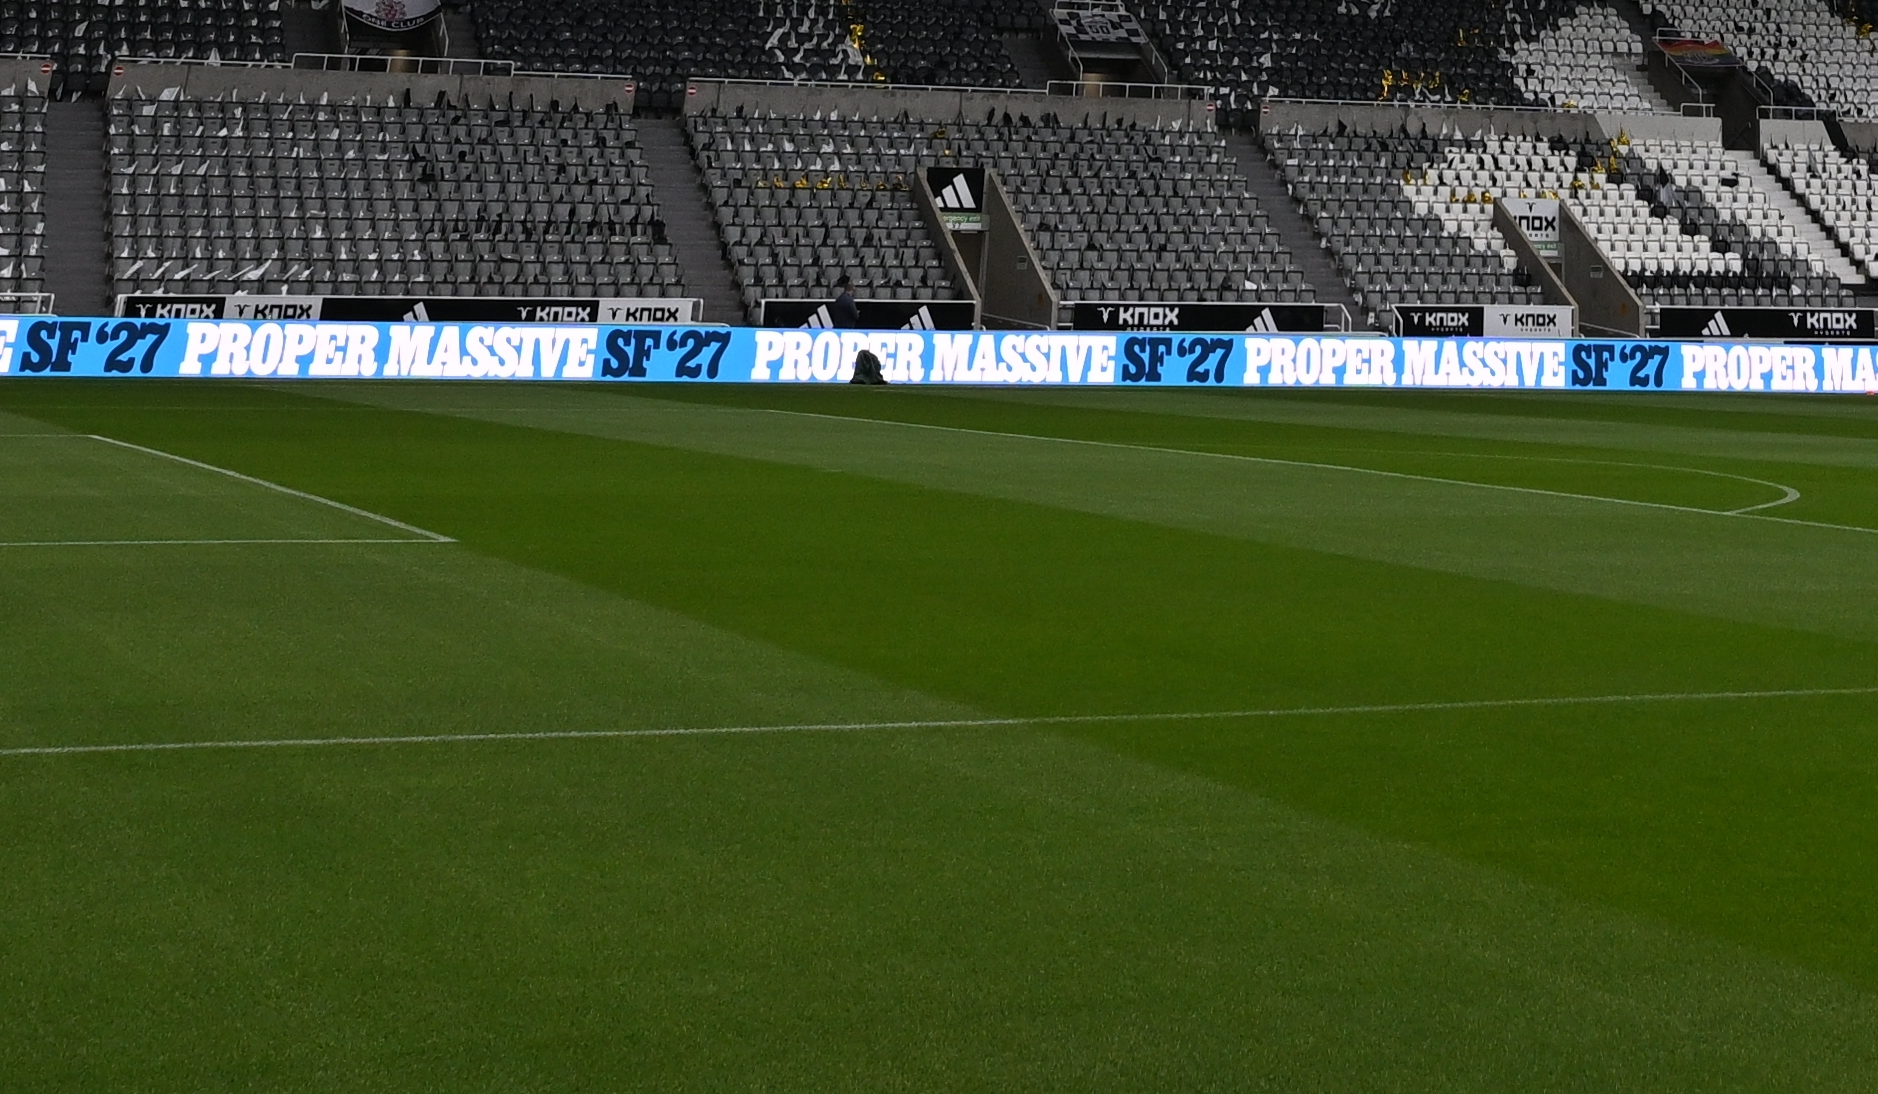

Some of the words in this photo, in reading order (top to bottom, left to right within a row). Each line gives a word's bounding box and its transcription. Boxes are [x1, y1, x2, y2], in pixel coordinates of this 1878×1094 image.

[1513, 216, 1555, 231] NOX
[156, 303, 217, 318] KNOX
[254, 305, 312, 319] KNOX
[535, 306, 592, 322] KNOX
[625, 308, 679, 322] KNOX
[1118, 306, 1181, 326] KNOX
[1425, 313, 1470, 327] KNOX
[1515, 315, 1557, 327] KNOX
[1806, 312, 1858, 329] KNOX
[21, 321, 91, 373] SF
[179, 322, 378, 377] PROPER
[383, 326, 598, 378] MASSIVE
[602, 330, 661, 378] SF
[931, 334, 1115, 384] MASSIVE
[1122, 336, 1173, 383] SF
[1244, 337, 1395, 385] PROPER
[1402, 340, 1565, 388] MASSIVE
[1572, 343, 1616, 387] SF
[1681, 344, 1817, 391] PROPER
